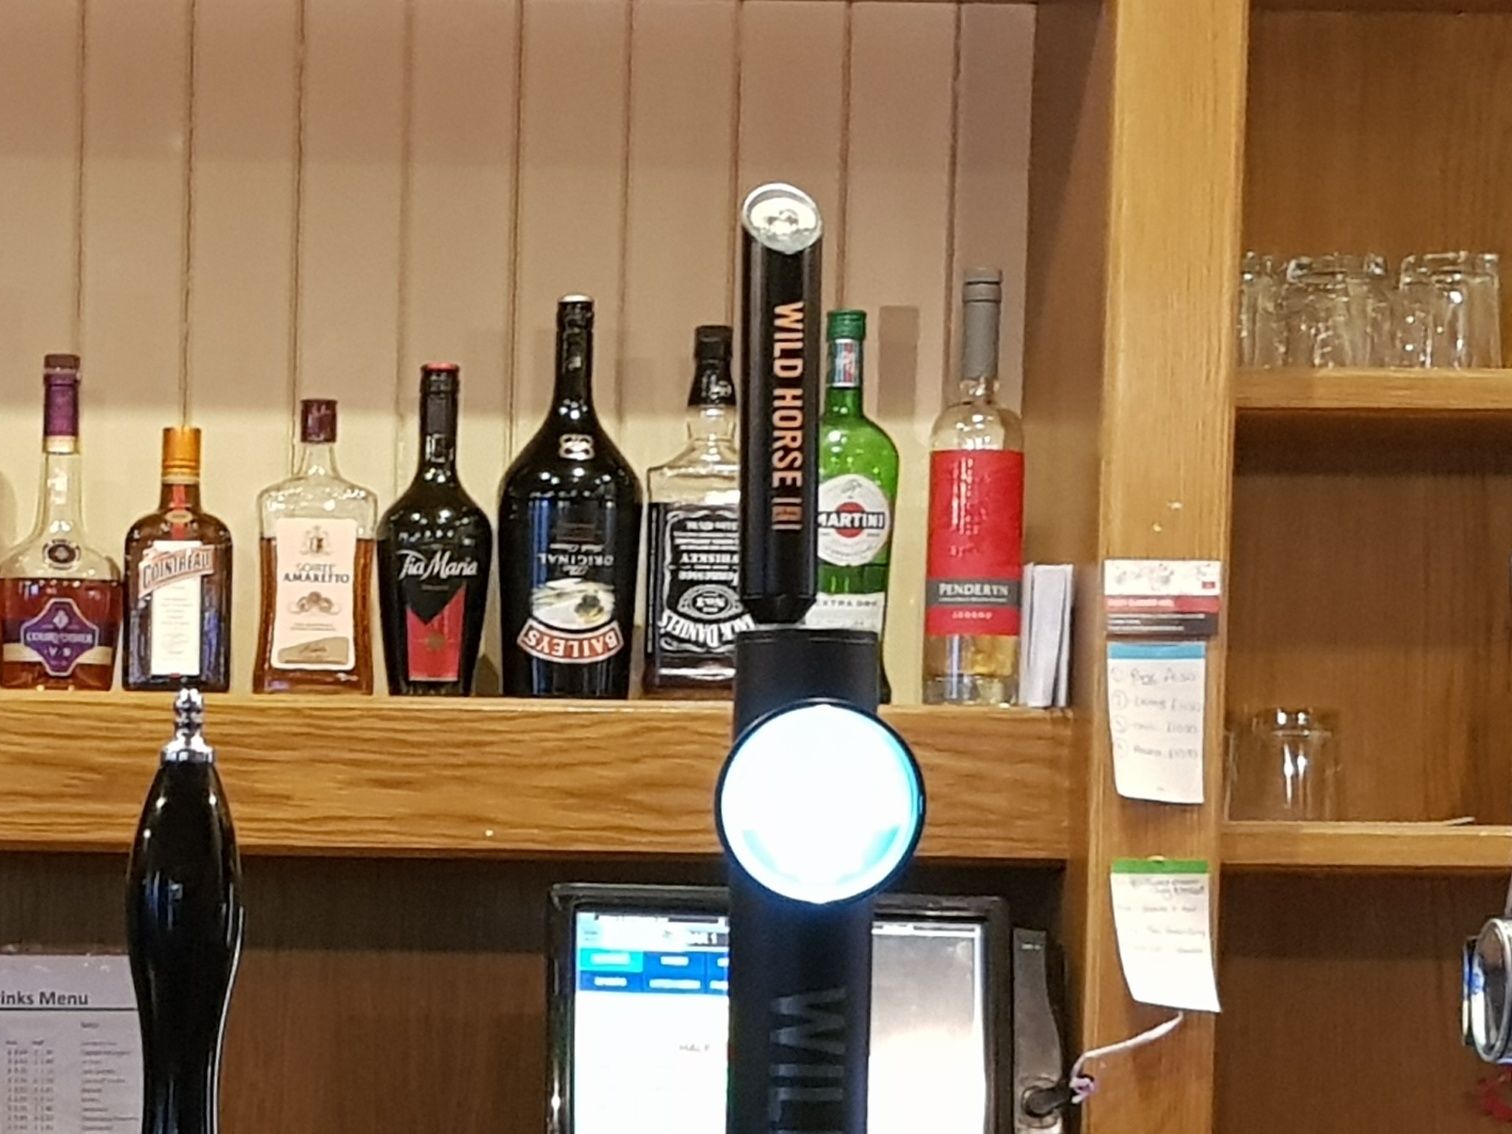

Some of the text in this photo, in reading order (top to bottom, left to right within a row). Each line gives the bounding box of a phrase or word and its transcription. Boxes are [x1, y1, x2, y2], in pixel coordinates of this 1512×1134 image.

[771, 301, 804, 488] WILD HORSE
[143, 550, 212, 589] COINTREAU
[396, 550, 478, 581] Tia Maria
[538, 553, 614, 565] ORIGINAL
[283, 572, 350, 584] AMARETTO
[938, 582, 1009, 597] PENDERYN
[525, 629, 618, 659] BAILEYS
[39, 991, 88, 1006] Menu
